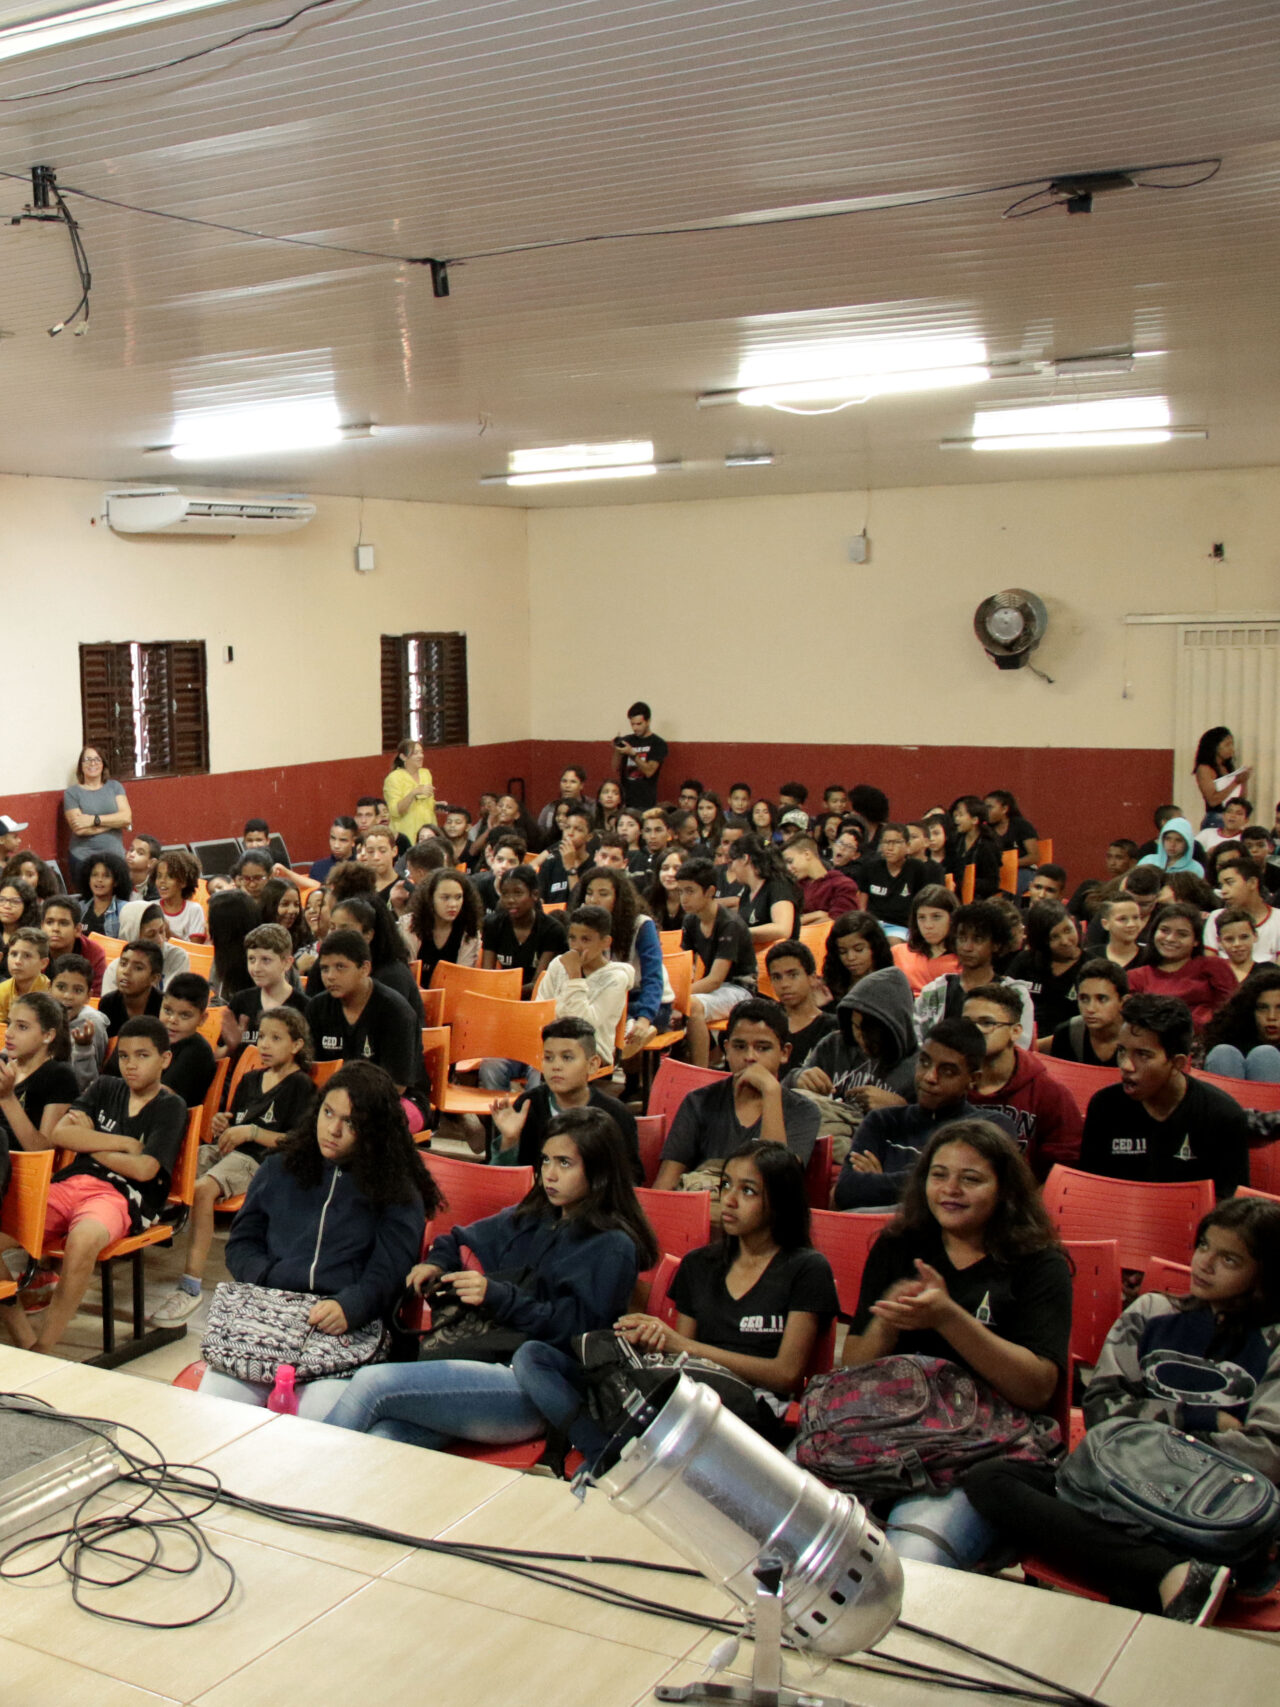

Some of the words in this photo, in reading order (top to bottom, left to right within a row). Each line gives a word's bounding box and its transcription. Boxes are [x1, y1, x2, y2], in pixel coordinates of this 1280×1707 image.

[1112, 1138, 1134, 1151] CED
[1136, 1138, 1147, 1151] 11
[740, 1315, 764, 1328] CED
[771, 1315, 784, 1329] 11
